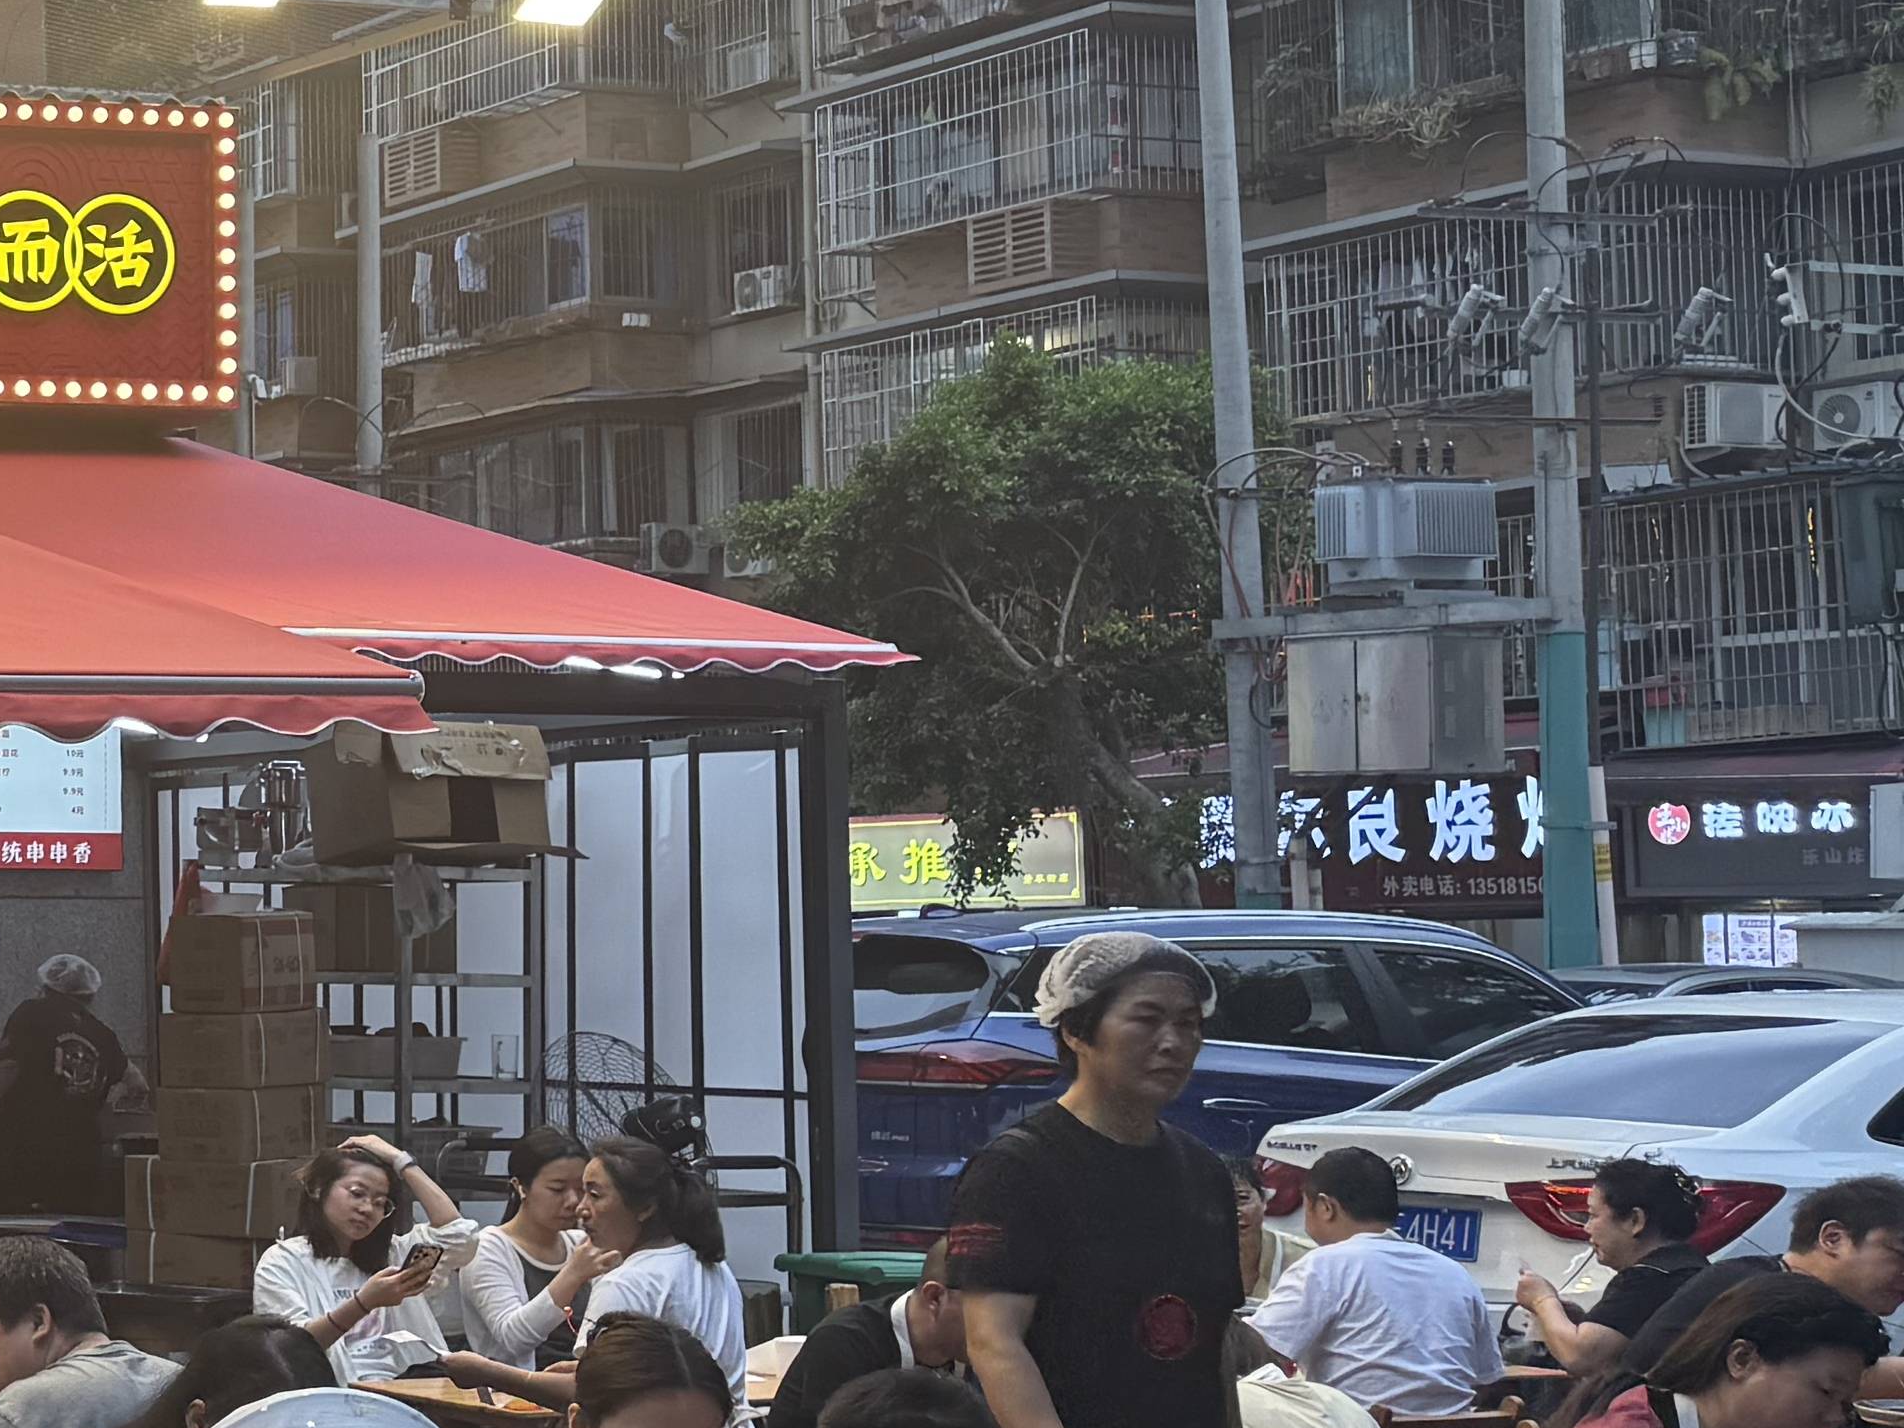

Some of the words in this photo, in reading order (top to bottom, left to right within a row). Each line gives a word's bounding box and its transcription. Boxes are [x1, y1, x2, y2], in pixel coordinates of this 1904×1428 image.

[1383, 874, 1462, 897] 外卖电话:
[1395, 1211, 1471, 1253] 4H41
